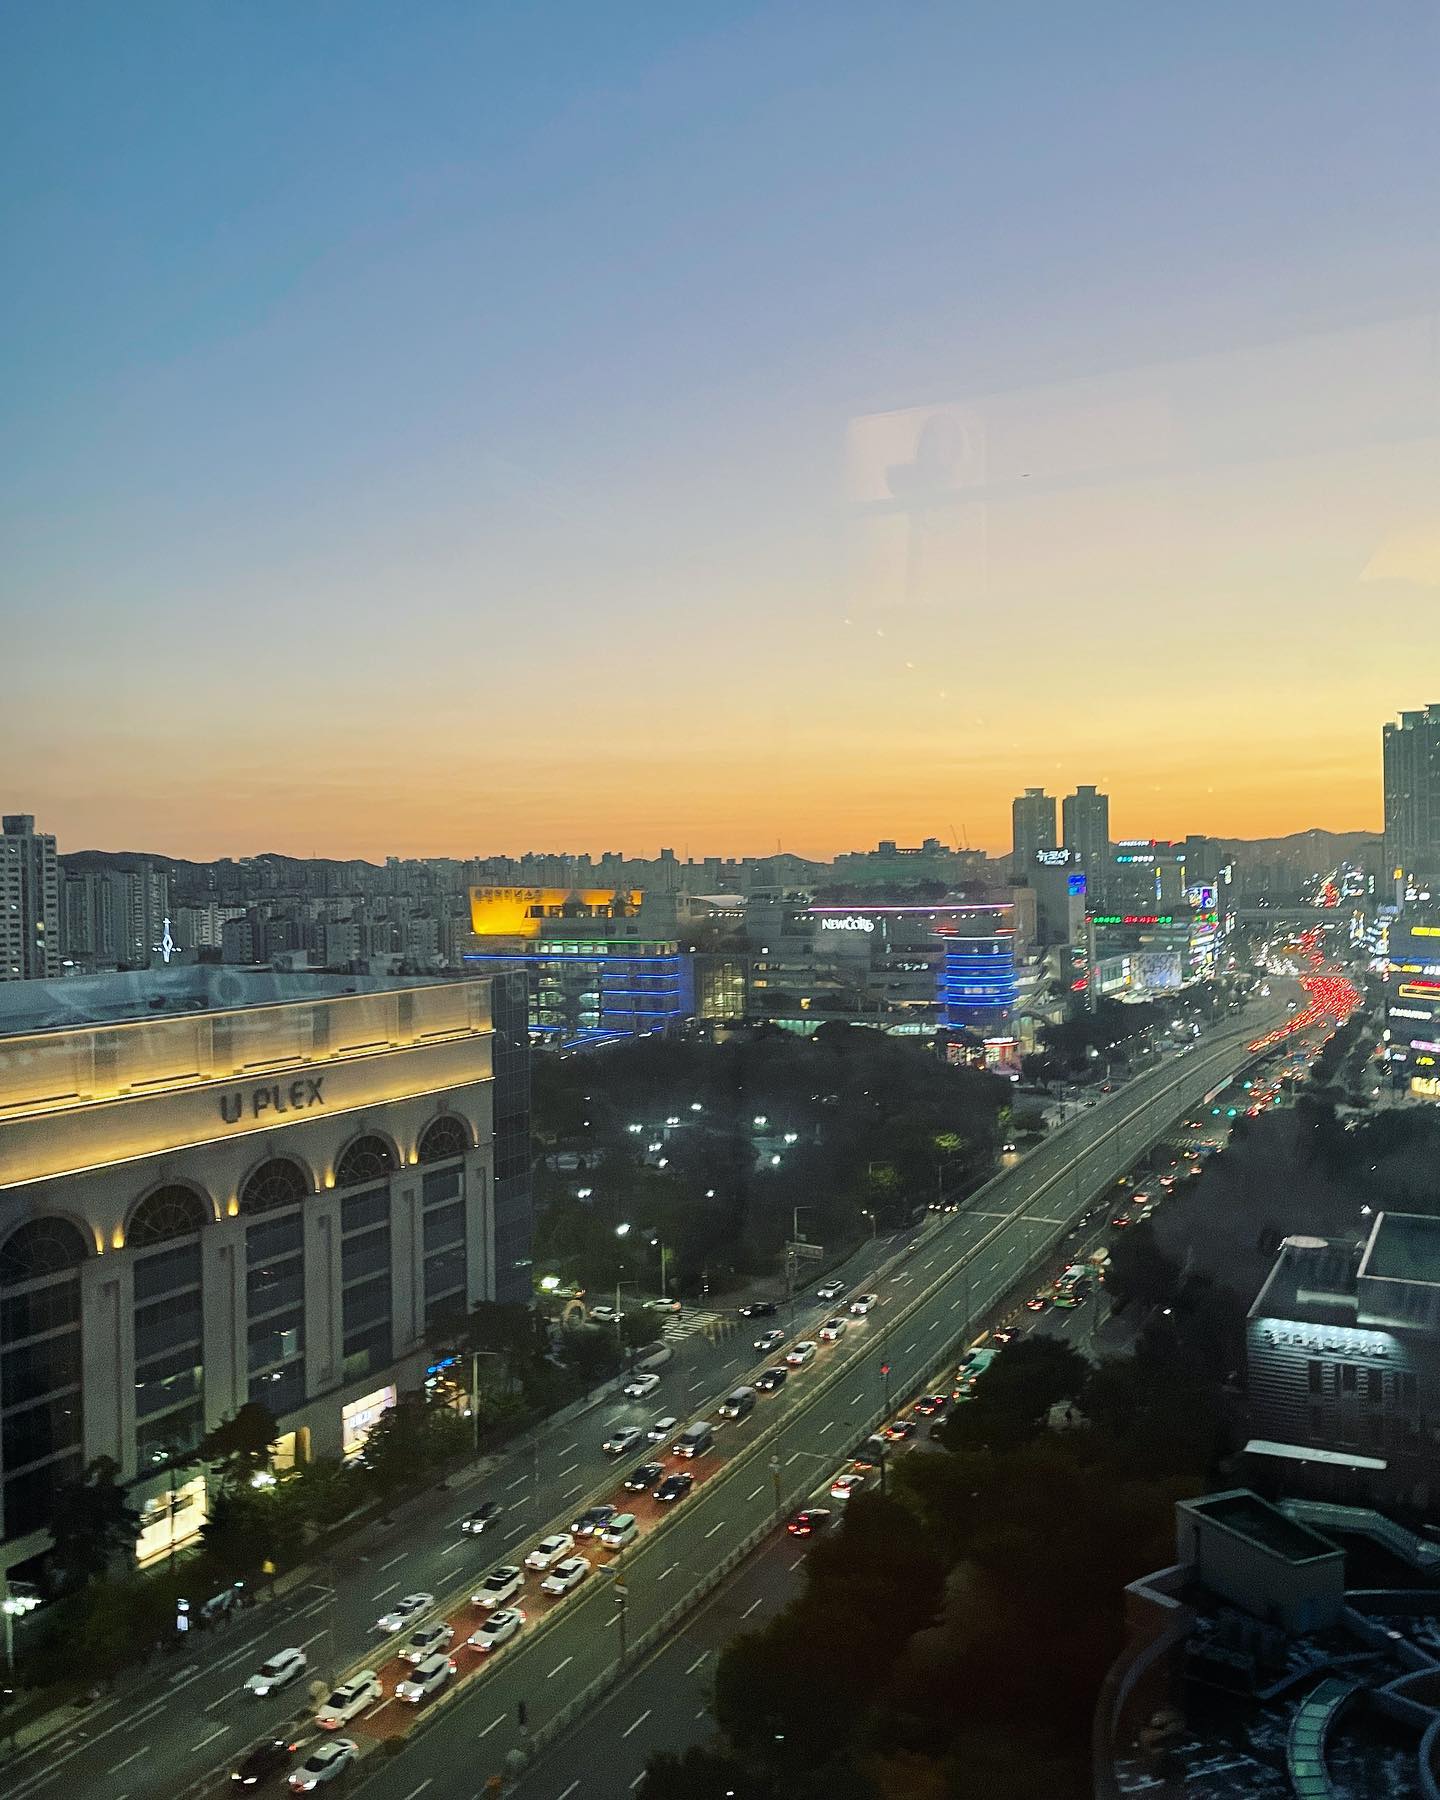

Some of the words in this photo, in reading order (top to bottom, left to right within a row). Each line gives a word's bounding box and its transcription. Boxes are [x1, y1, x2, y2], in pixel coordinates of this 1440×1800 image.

[1035, 849, 1071, 862] 뉴코아
[220, 1092, 243, 1124] U
[252, 1076, 325, 1119] PLEX
